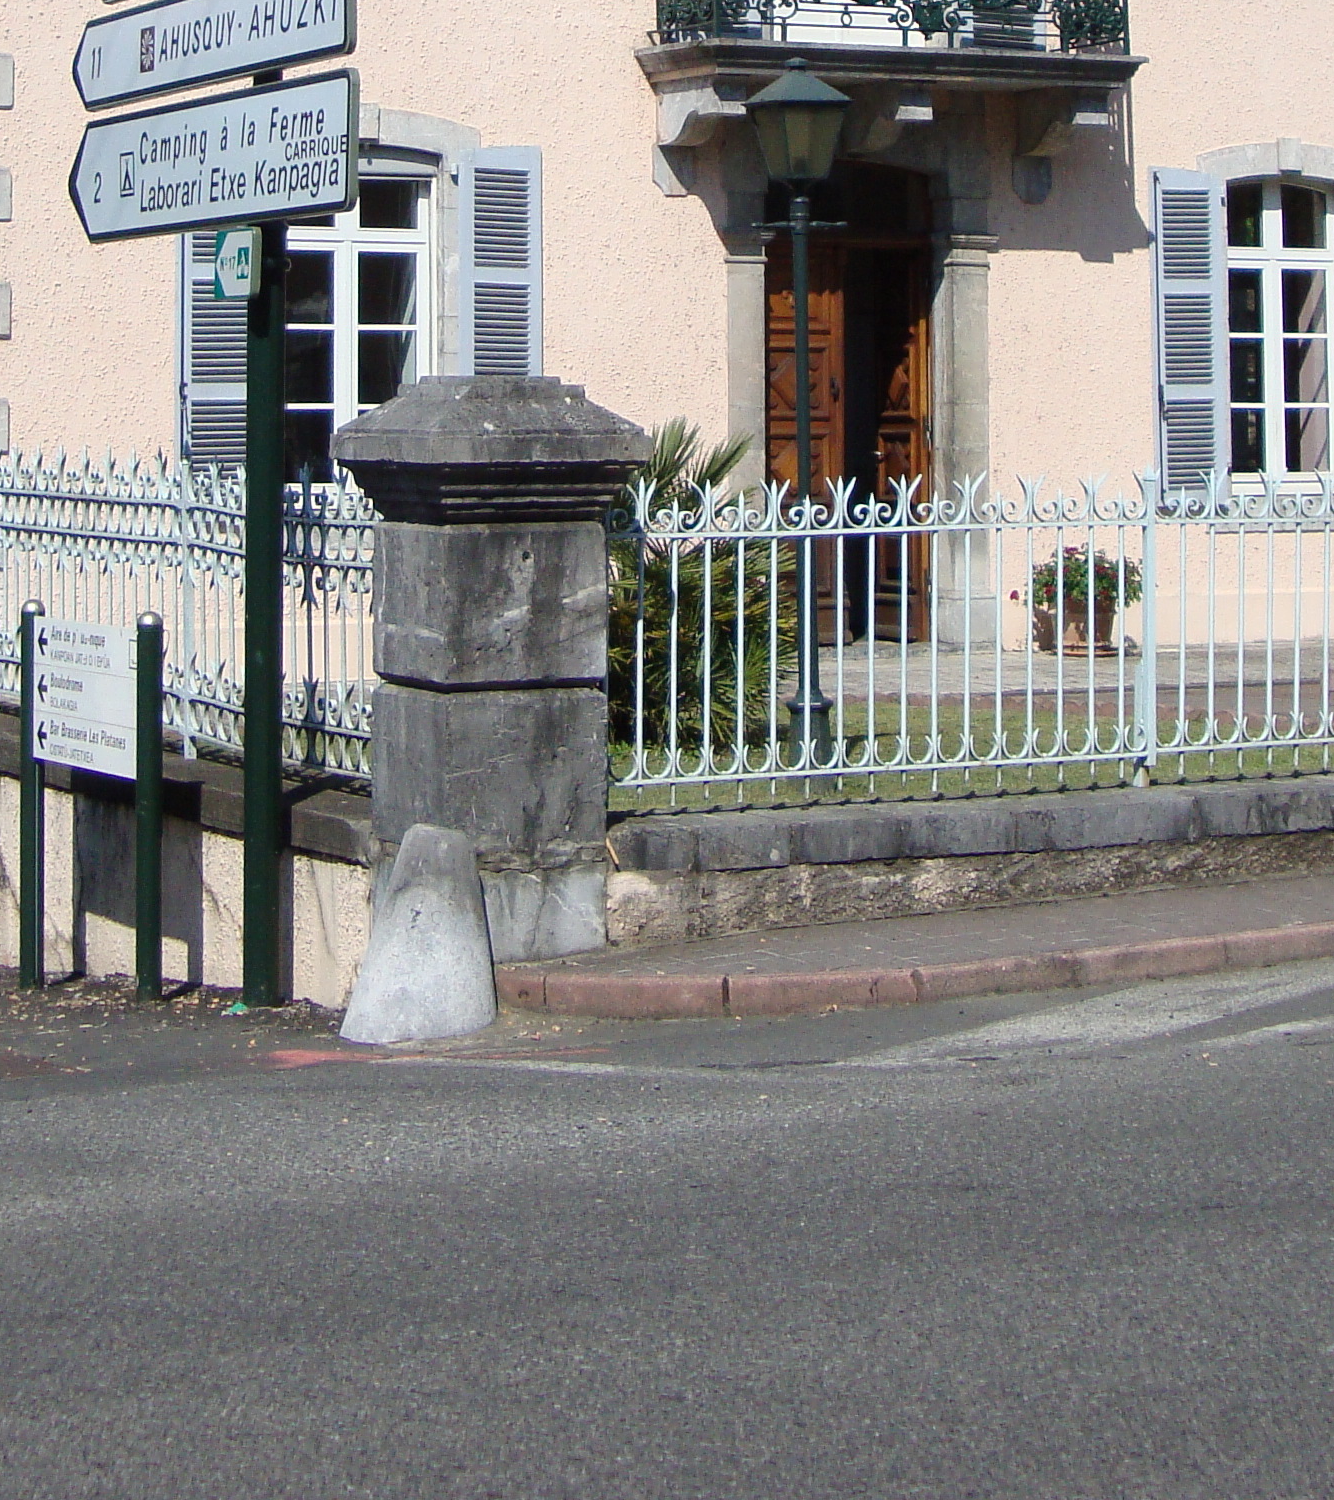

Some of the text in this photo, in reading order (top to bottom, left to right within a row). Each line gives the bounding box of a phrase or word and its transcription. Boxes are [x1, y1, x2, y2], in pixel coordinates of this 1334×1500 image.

[91, 46, 102, 80] 11
[139, 106, 325, 169] Camping à la Ferme
[284, 134, 348, 162] CARRIQUE
[93, 171, 102, 204] 2
[140, 157, 340, 213] Laborari Etxe Kanpagia
[50, 720, 60, 736] Bar
[61, 722, 87, 742] Brasserie
[100, 730, 126, 750] Platanes
